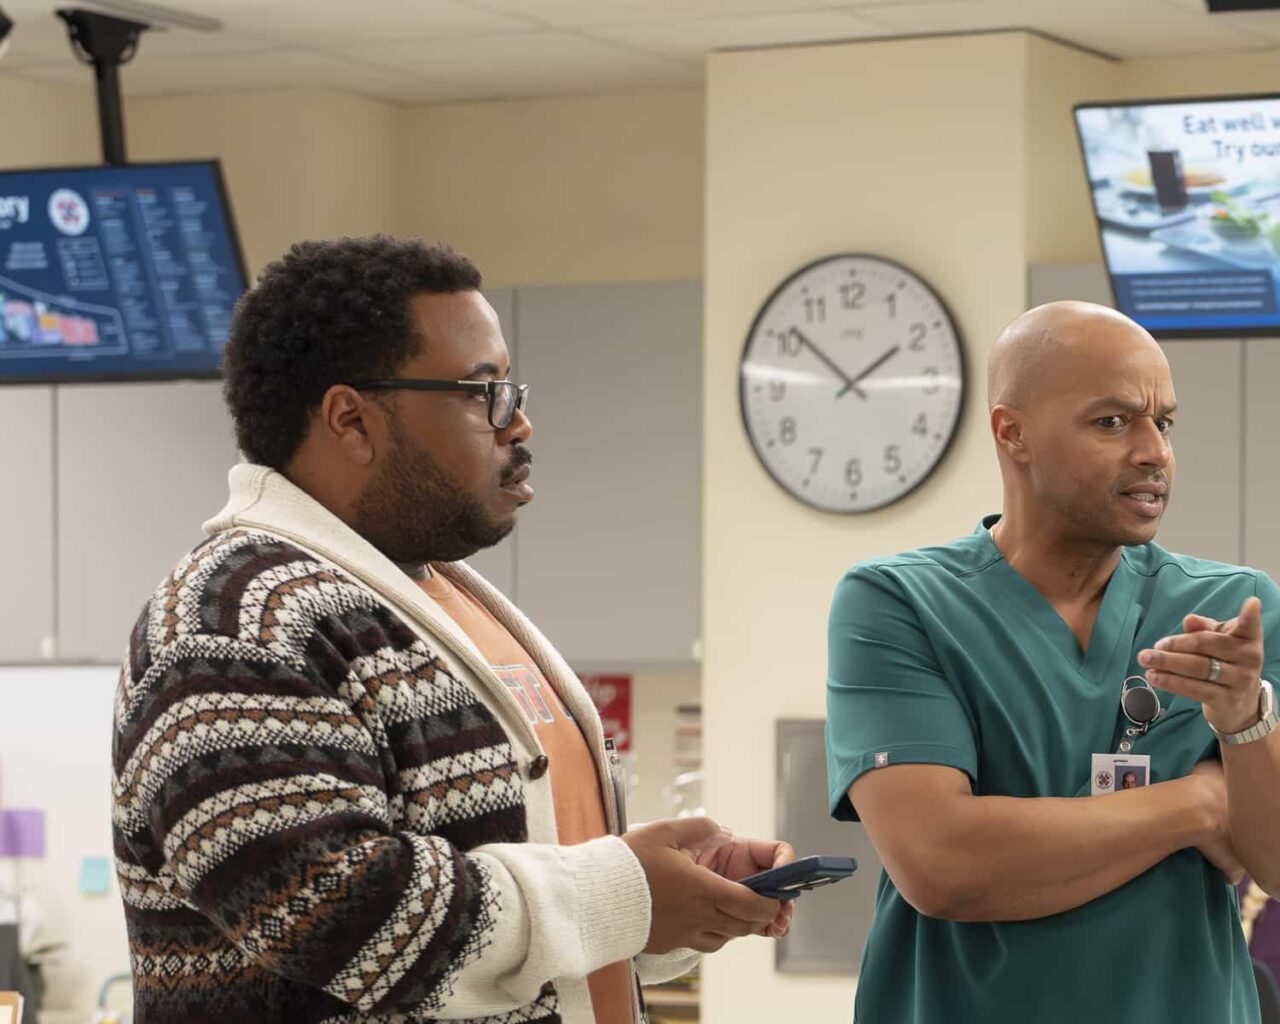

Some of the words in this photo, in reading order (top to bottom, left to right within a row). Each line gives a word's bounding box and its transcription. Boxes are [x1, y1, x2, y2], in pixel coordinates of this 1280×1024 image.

[1183, 114, 1217, 134] Eat
[1223, 113, 1265, 132] well
[1213, 139, 1245, 163] Try
[804, 296, 826, 323] 11
[839, 282, 867, 310] 12
[886, 293, 896, 318] 1
[776, 326, 802, 357] 10
[908, 322, 927, 352] 2
[767, 382, 786, 401] 9
[922, 365, 940, 395] 3
[779, 416, 797, 446] 8
[912, 413, 927, 437] 4
[809, 448, 823, 475] 7
[844, 458, 862, 486] 6
[884, 444, 901, 473] 5
